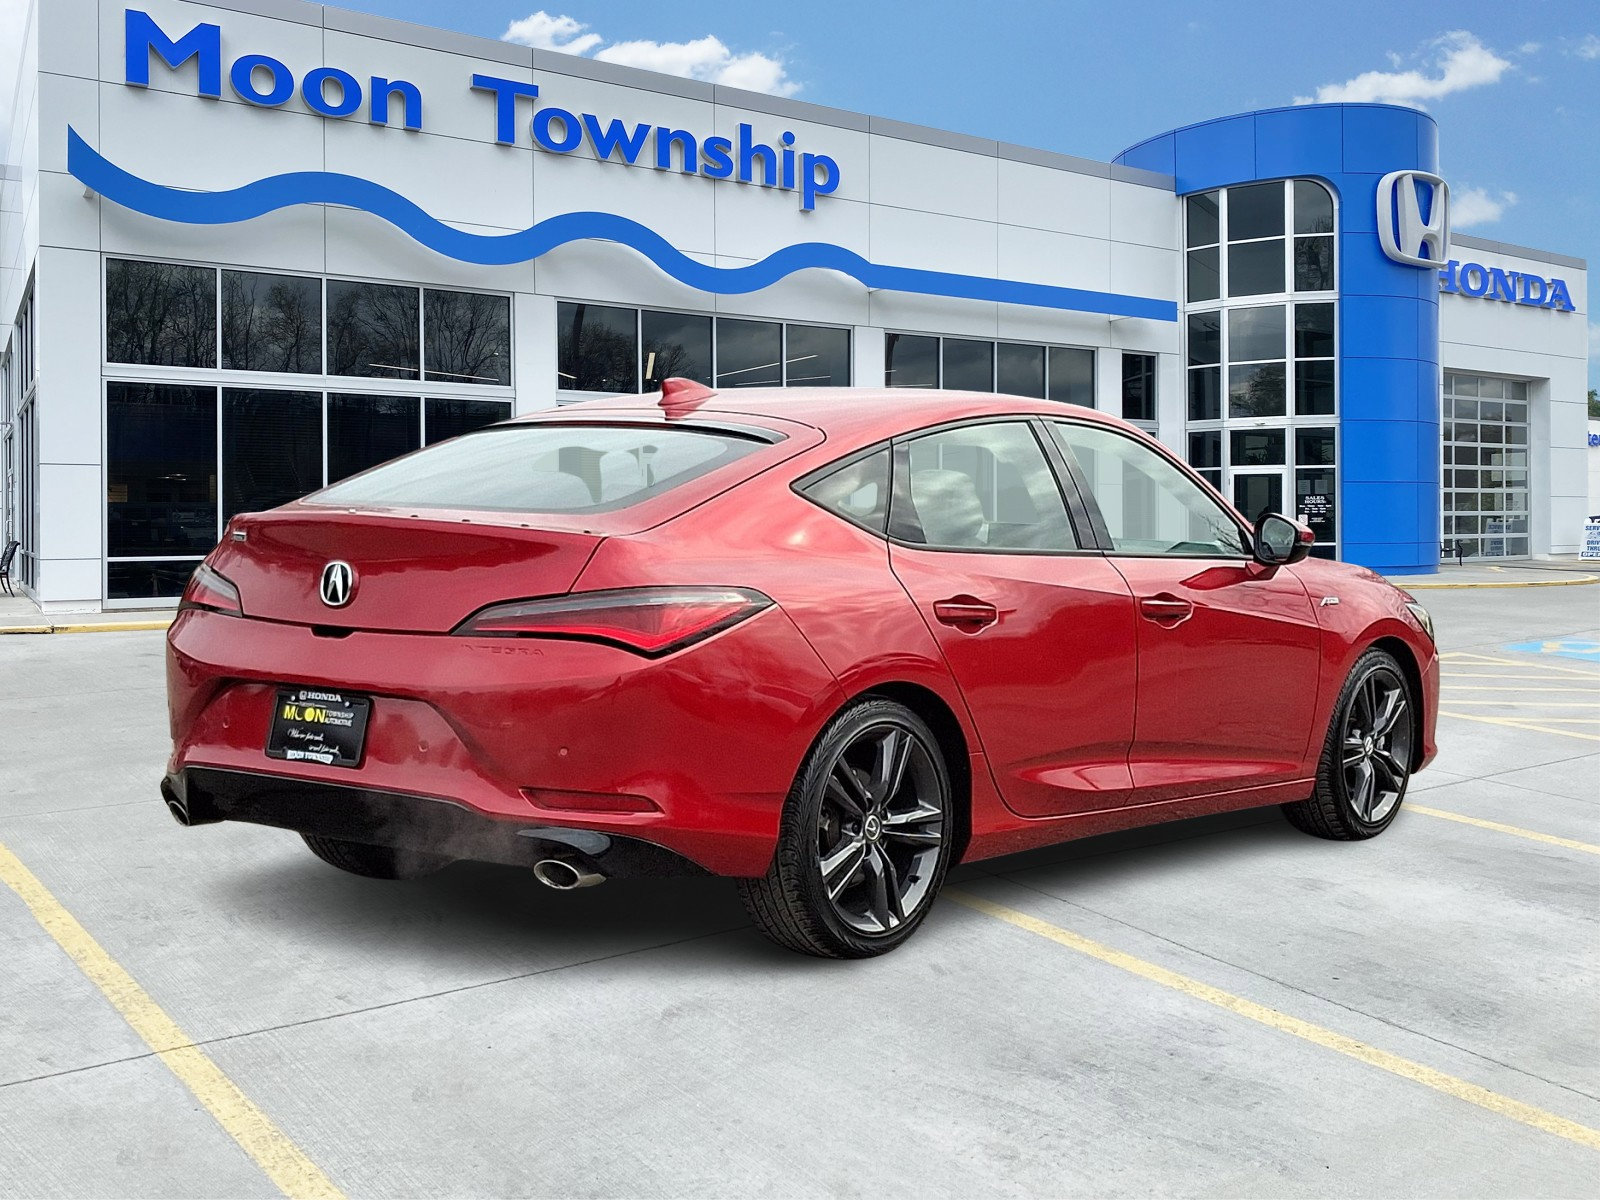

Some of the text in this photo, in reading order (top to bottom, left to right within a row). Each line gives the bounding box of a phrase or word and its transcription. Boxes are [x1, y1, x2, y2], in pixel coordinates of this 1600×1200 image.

[125, 9, 841, 211] Moon Township
[1439, 260, 1576, 312] HONDA
[307, 691, 342, 702] HONDA
